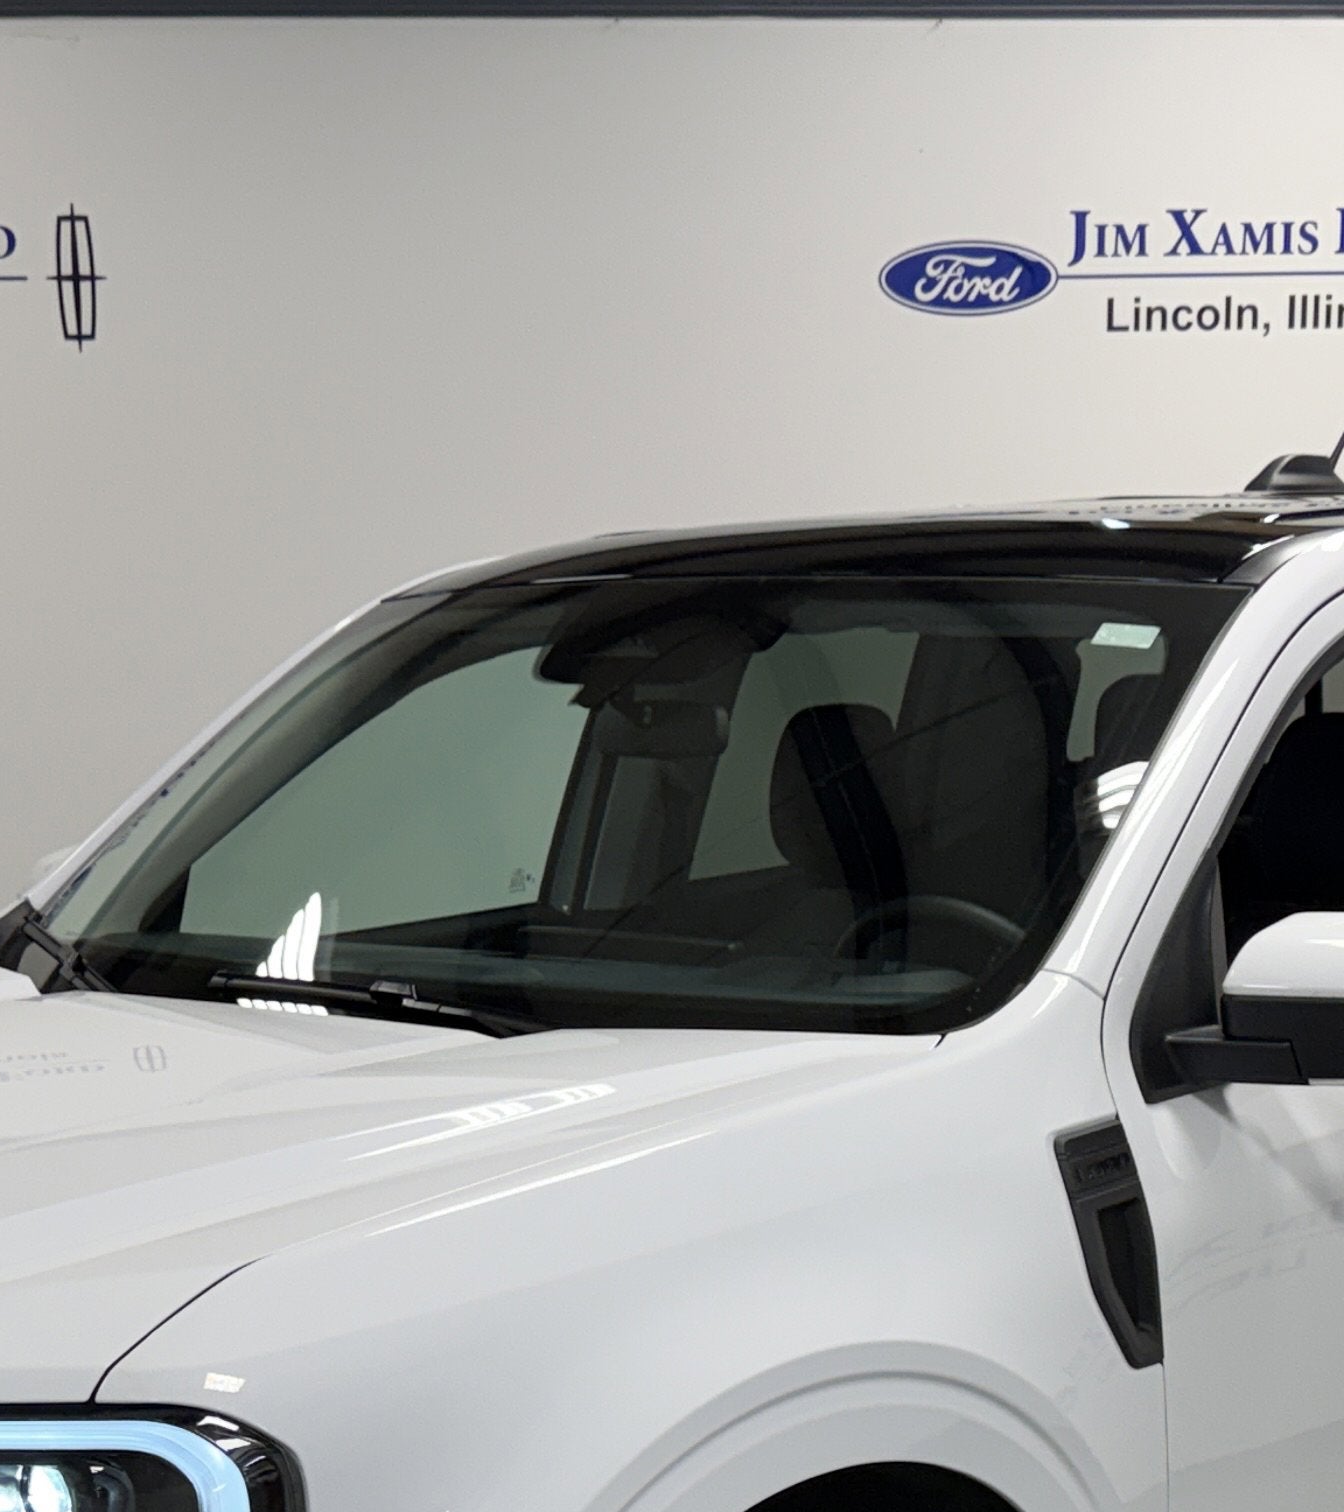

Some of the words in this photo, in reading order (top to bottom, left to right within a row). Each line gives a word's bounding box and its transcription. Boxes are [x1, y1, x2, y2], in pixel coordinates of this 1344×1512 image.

[1067, 210, 1148, 267] JIM
[1163, 208, 1319, 257] XAMIS
[913, 252, 1022, 304] Ford
[1106, 295, 1270, 337] Lincoln,
